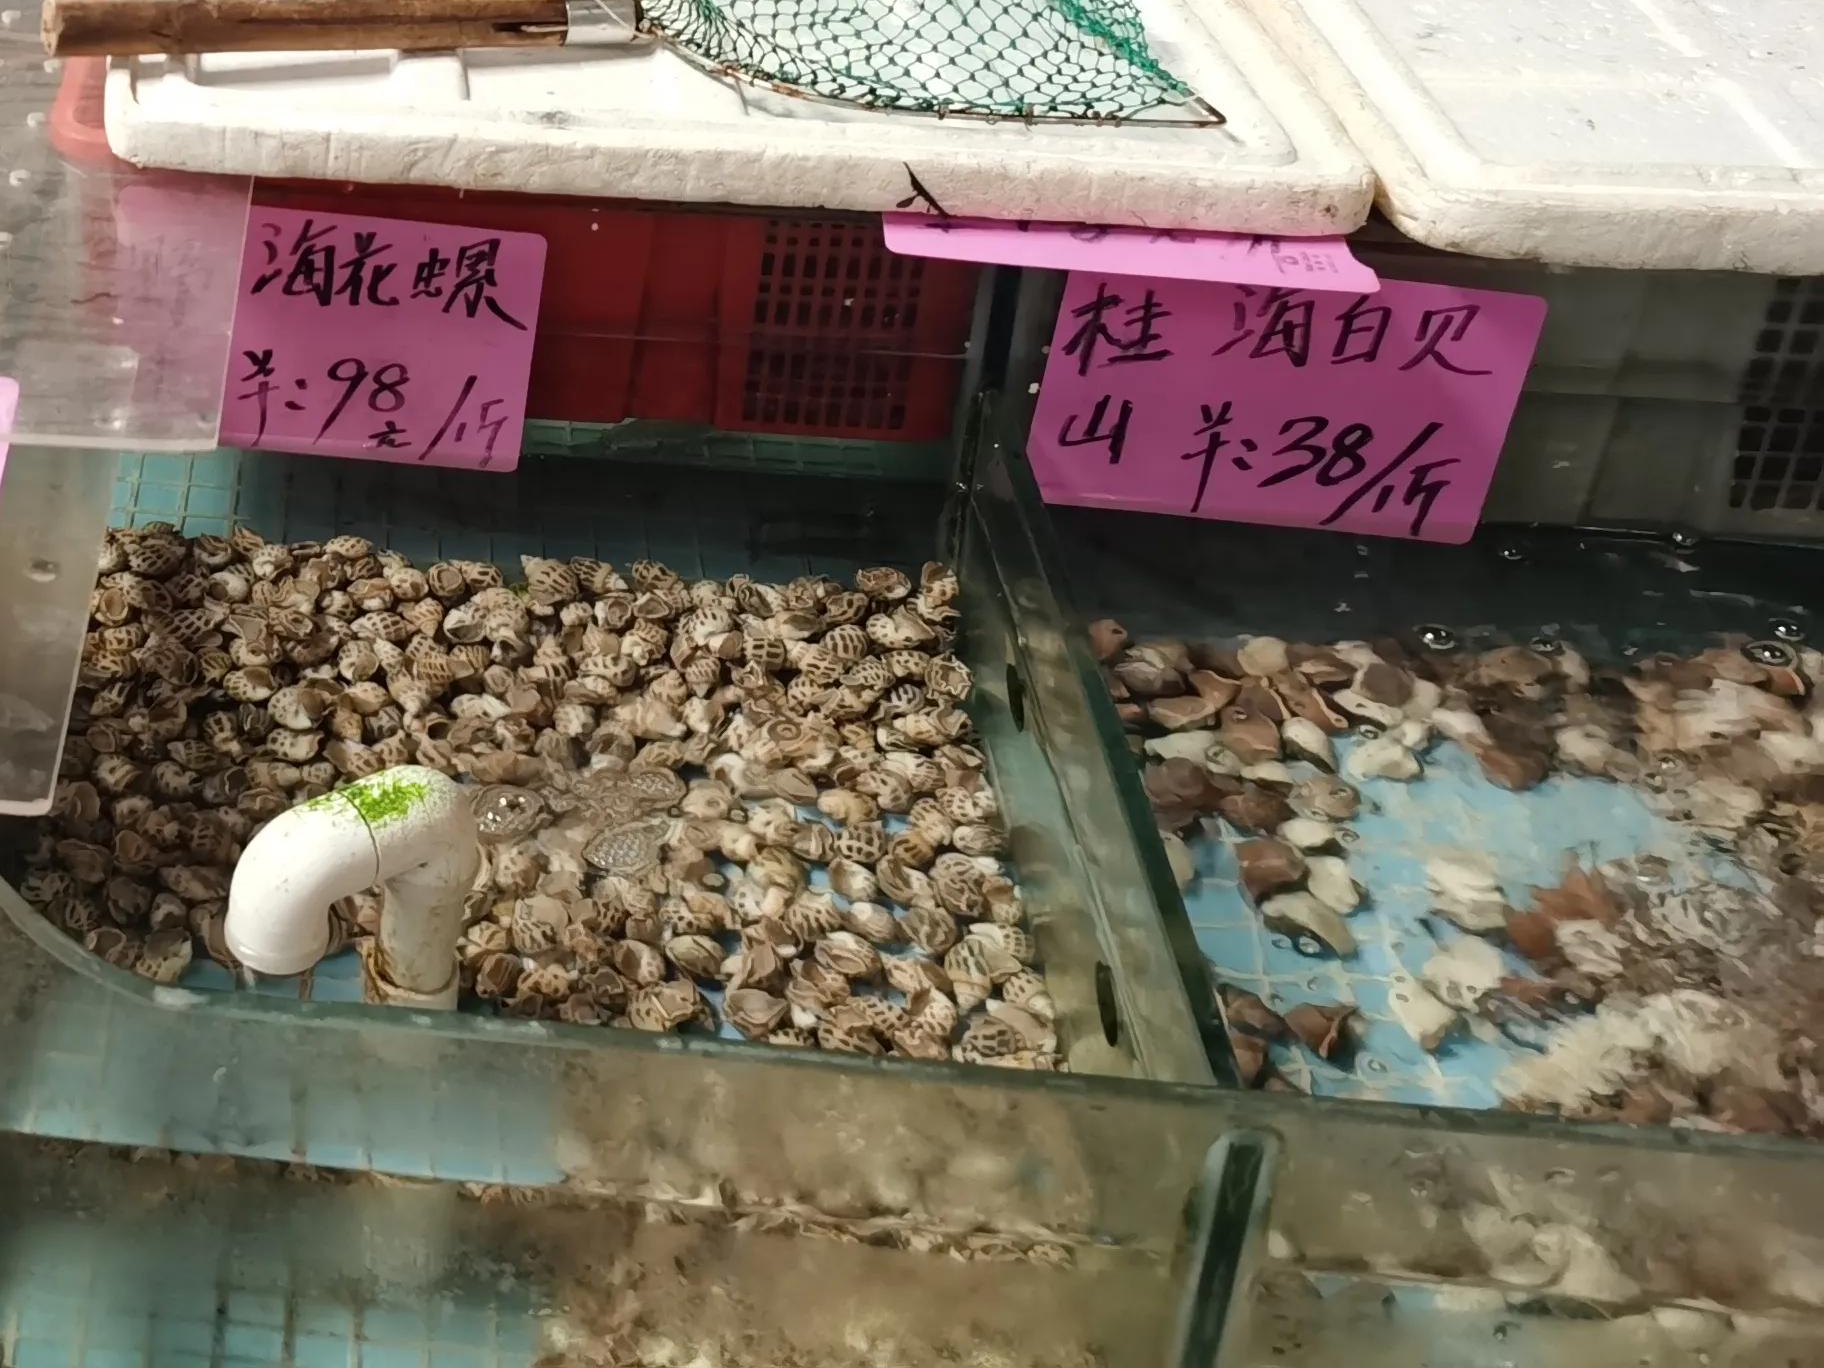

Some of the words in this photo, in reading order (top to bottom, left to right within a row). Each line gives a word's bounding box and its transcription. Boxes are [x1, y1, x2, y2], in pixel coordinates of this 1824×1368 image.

[250, 219, 528, 331] 海花螺
[1211, 286, 1493, 375] 海白贝
